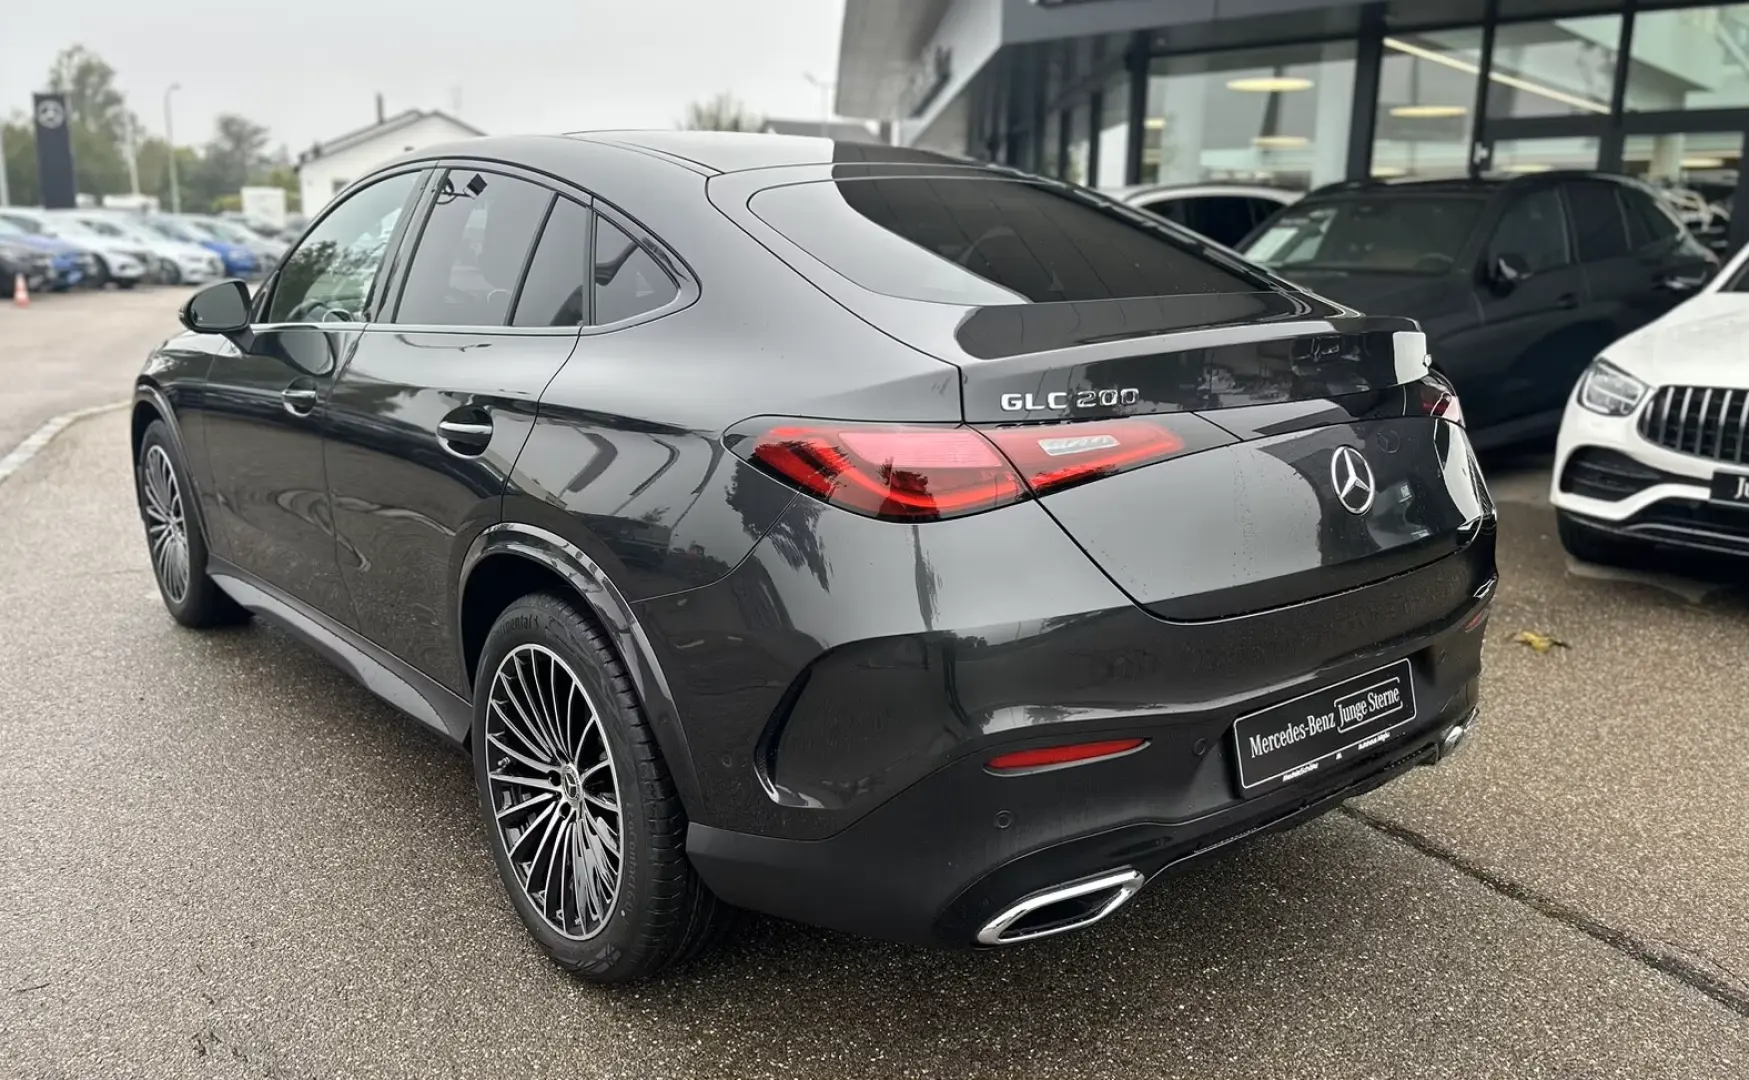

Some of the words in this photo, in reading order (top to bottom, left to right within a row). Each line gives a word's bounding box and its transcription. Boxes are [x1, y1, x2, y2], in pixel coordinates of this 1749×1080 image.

[1001, 392, 1067, 411] GLC
[1076, 388, 1140, 408] 200
[1249, 712, 1335, 758] Mercedes-Benz
[1337, 702, 1368, 727] Junge
[1367, 687, 1400, 713] Sterne
